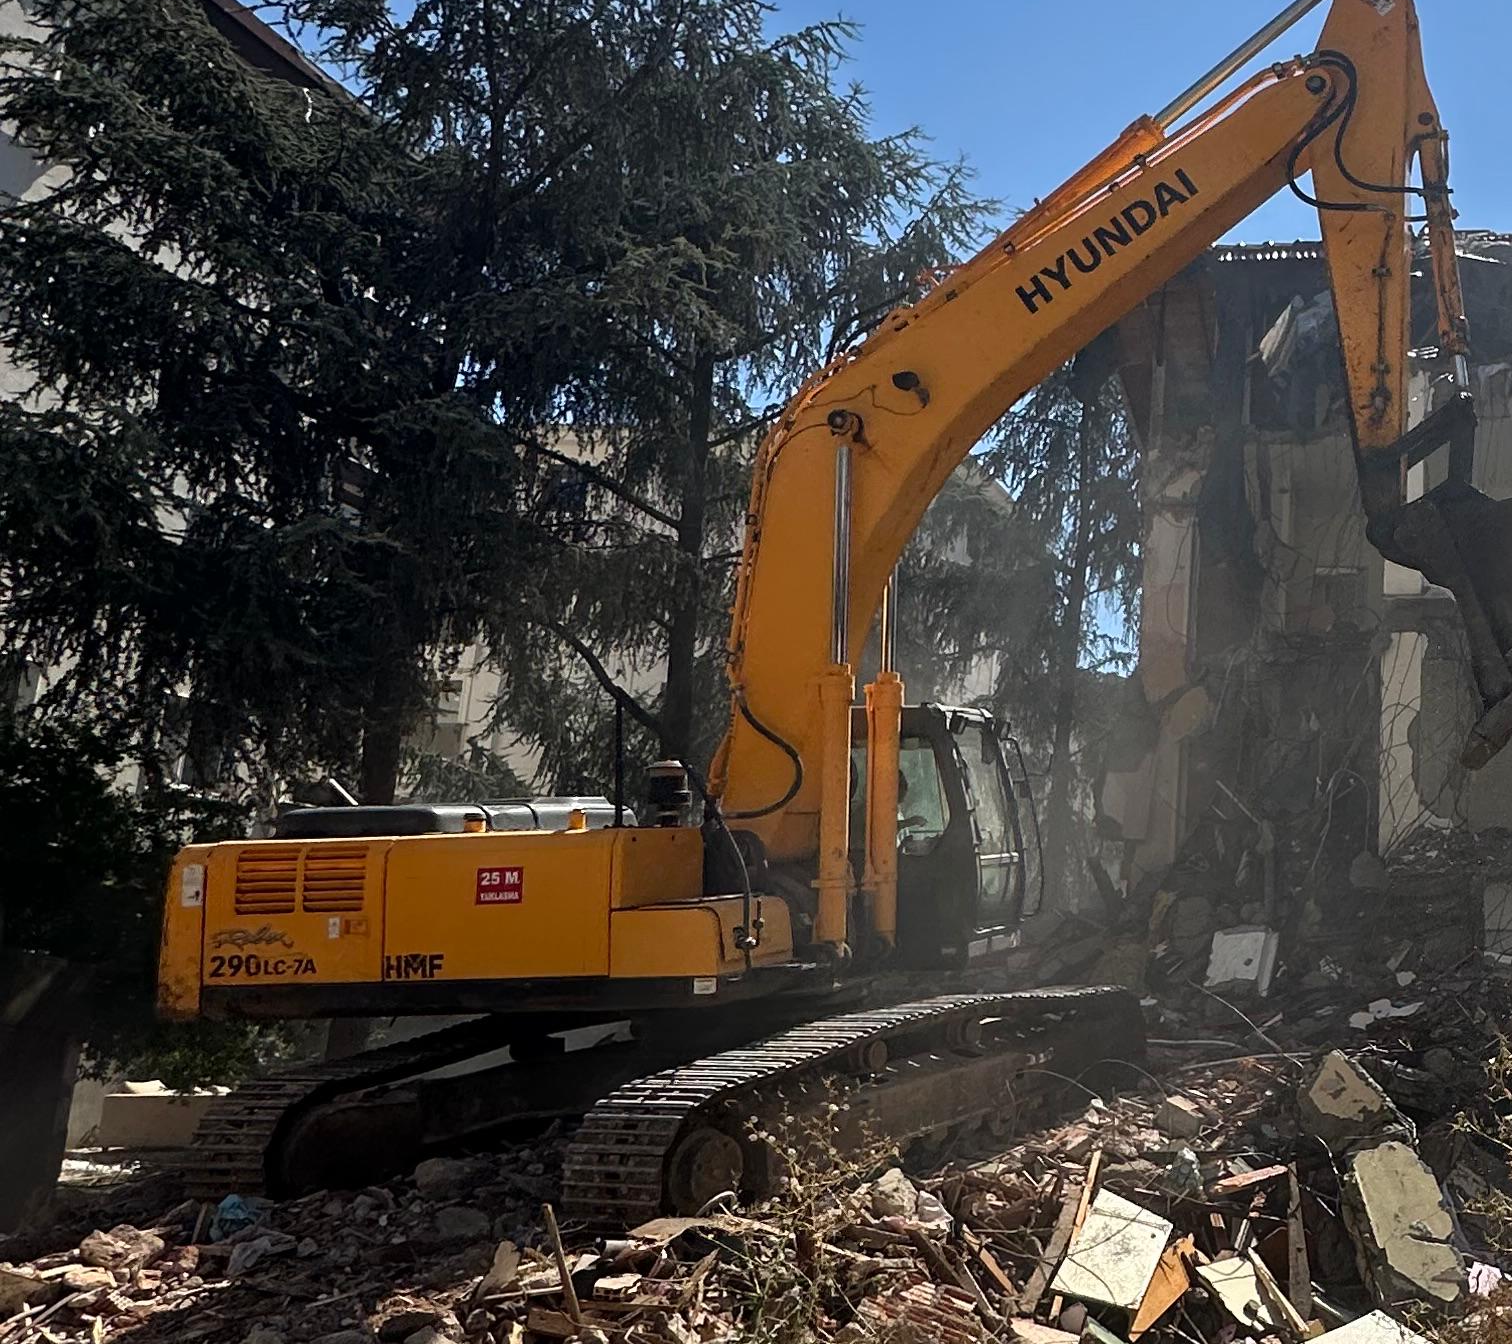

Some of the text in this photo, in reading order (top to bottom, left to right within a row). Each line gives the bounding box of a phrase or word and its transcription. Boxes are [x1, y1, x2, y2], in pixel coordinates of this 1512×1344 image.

[1015, 168, 1199, 314] HYUNDAI
[480, 871, 520, 886] 25 M
[385, 954, 444, 978] HMF
